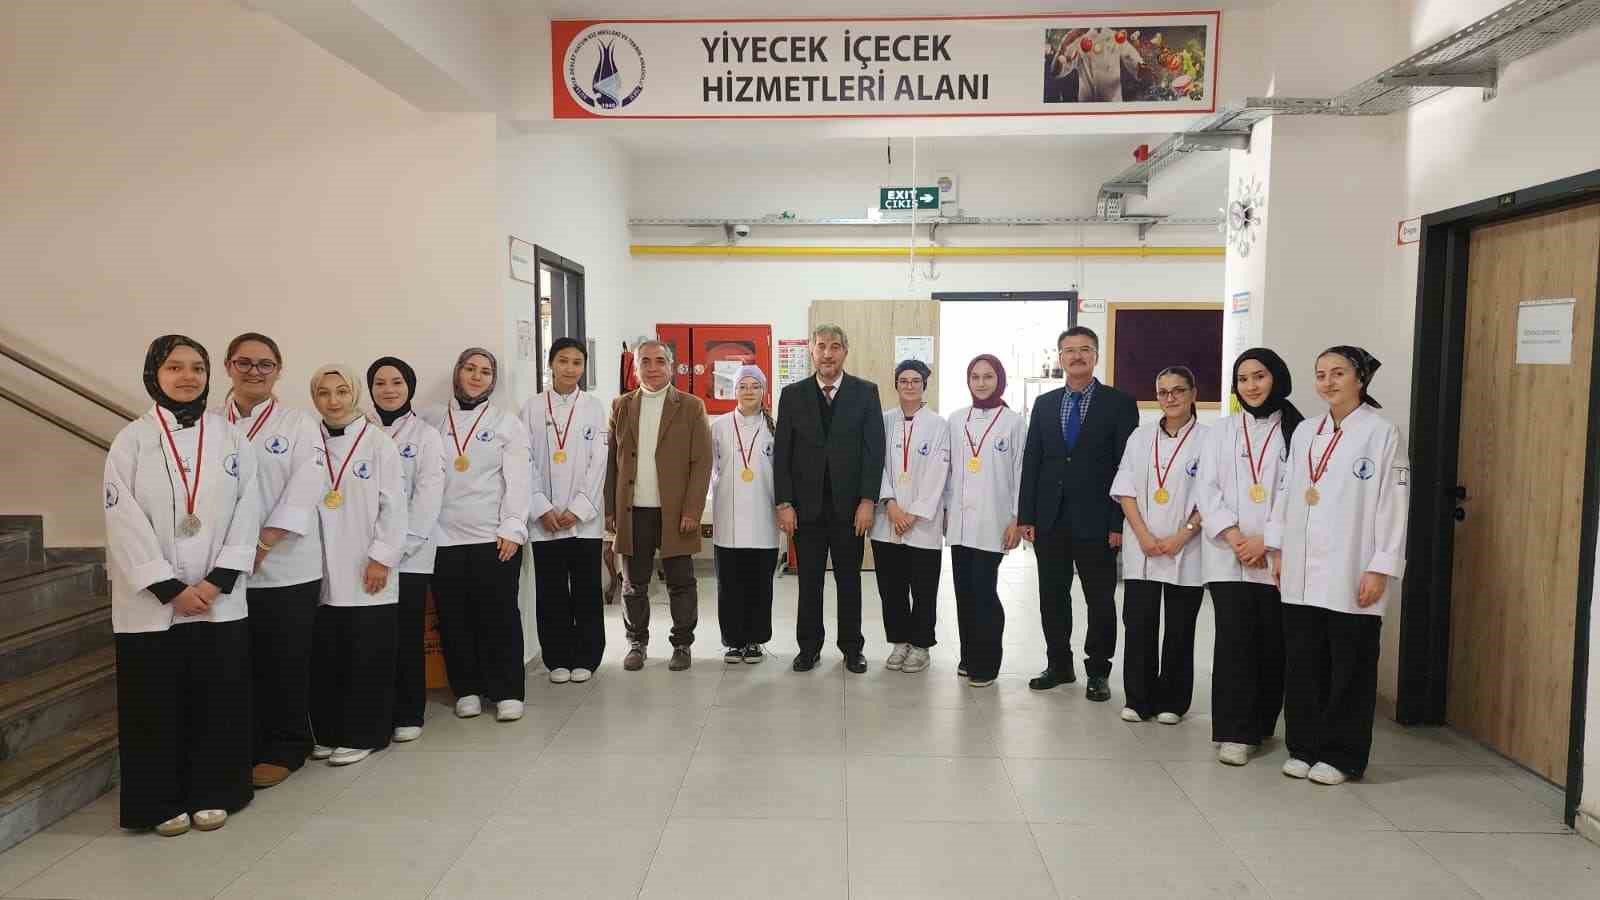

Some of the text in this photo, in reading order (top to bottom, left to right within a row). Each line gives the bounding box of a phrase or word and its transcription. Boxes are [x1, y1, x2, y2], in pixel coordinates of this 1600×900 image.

[701, 29, 951, 70] YİYECEK İÇECEK
[703, 70, 988, 102] HİZMETLERİ ALANI
[888, 190, 917, 200] EXIT
